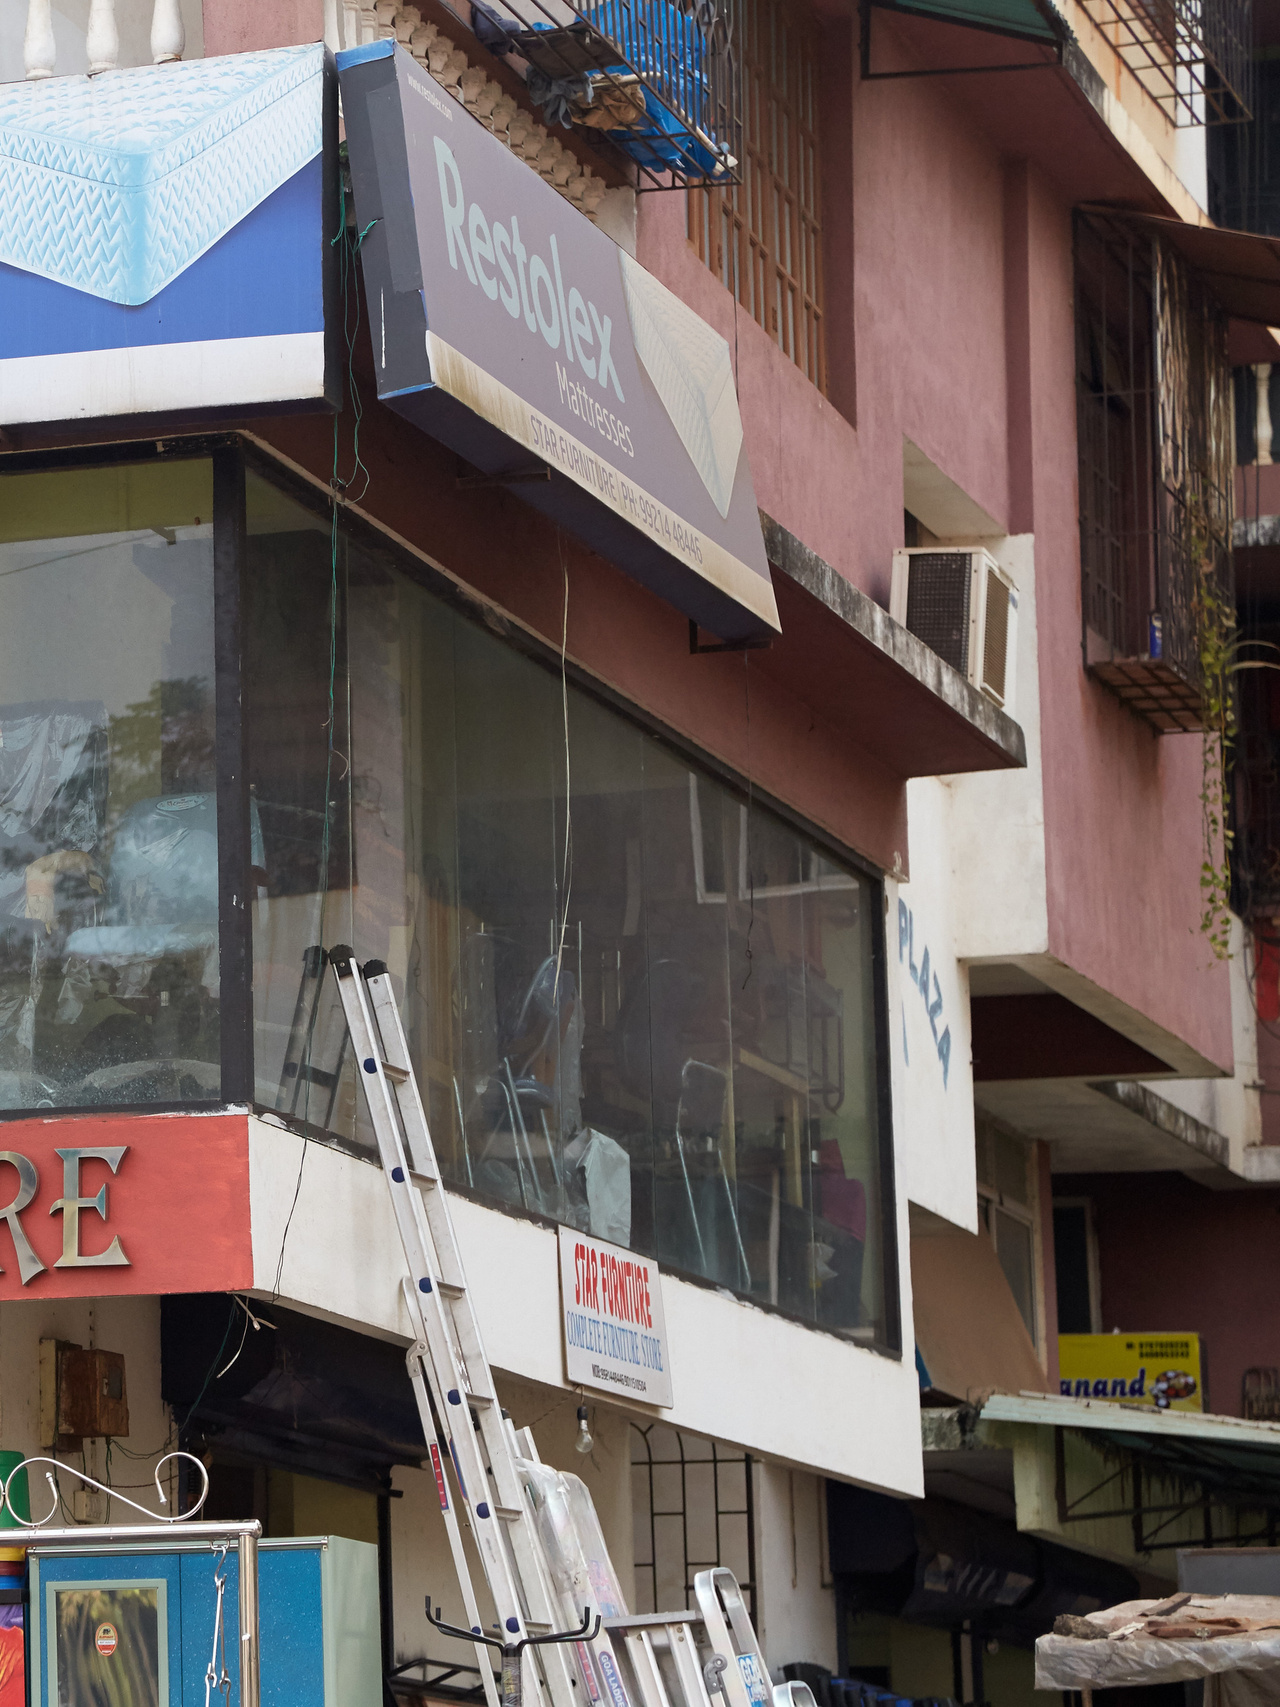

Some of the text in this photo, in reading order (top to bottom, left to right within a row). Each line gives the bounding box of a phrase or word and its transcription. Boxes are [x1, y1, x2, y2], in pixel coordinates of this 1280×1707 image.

[433, 136, 625, 403] Restolex
[556, 361, 635, 458] Mattresses
[530, 414, 703, 565] STAR FURNITURE PH: 99214 48446
[898, 896, 951, 1092] PLAZA
[574, 1242, 653, 1330] STAR FURNITURE
[566, 1310, 664, 1372] COMPLETE FURNITURE STORE
[601, 1654, 614, 1677] GOA
